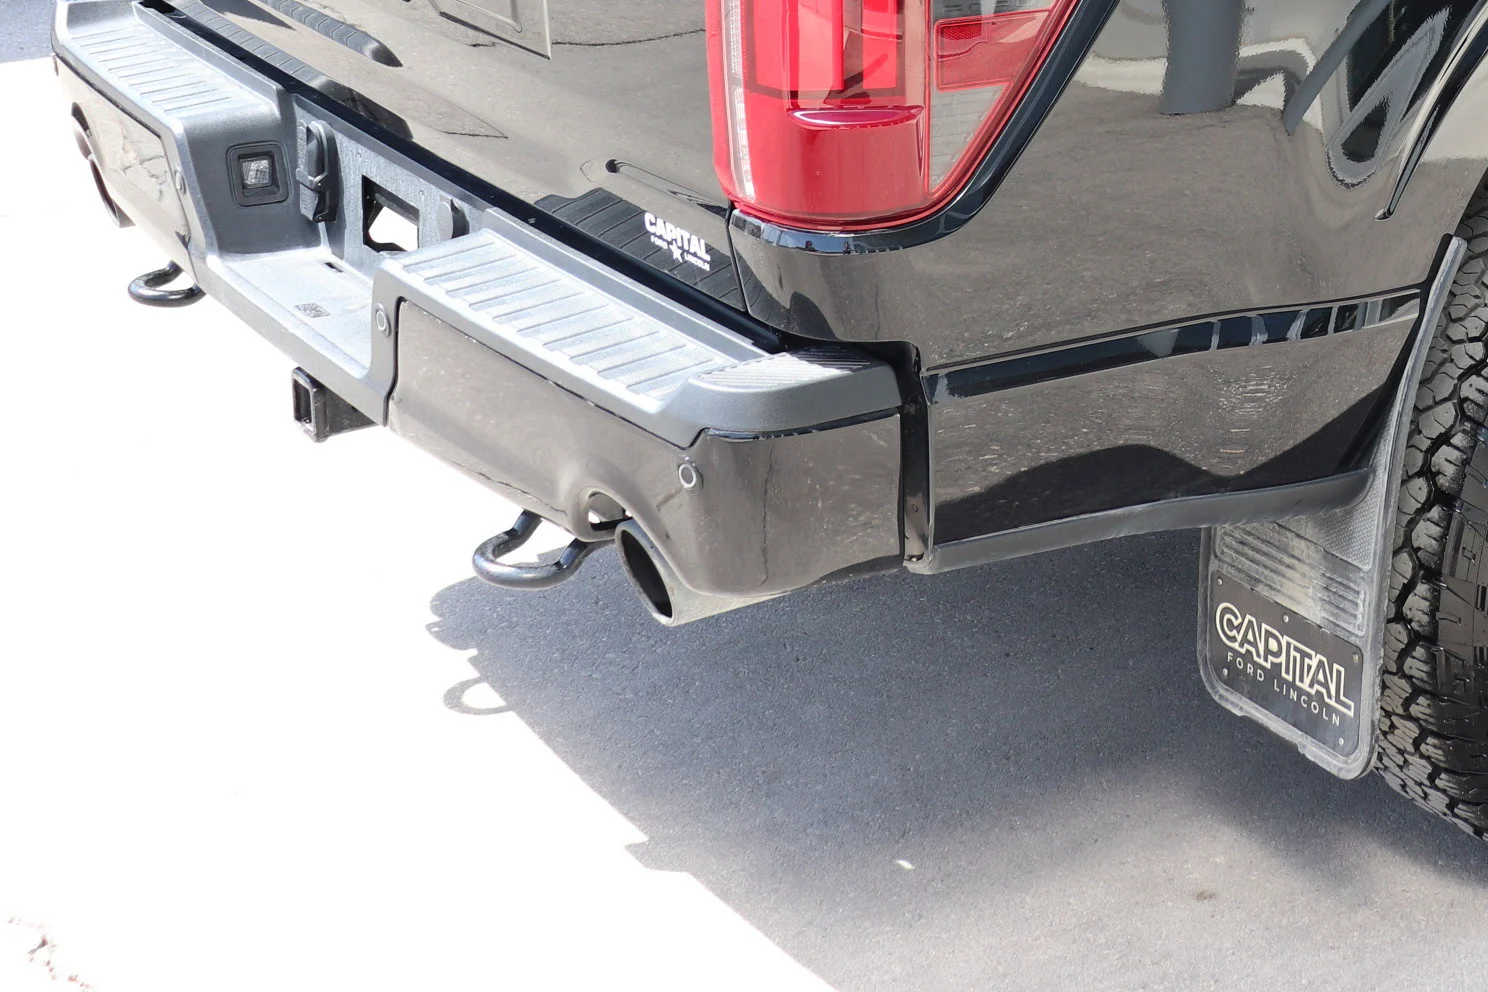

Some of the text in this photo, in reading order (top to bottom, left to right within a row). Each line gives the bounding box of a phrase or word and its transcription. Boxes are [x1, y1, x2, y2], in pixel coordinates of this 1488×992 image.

[643, 211, 712, 262] CAPITAL
[1215, 601, 1355, 718] CAPITAL
[1227, 651, 1340, 727] FORD LINCOLN
